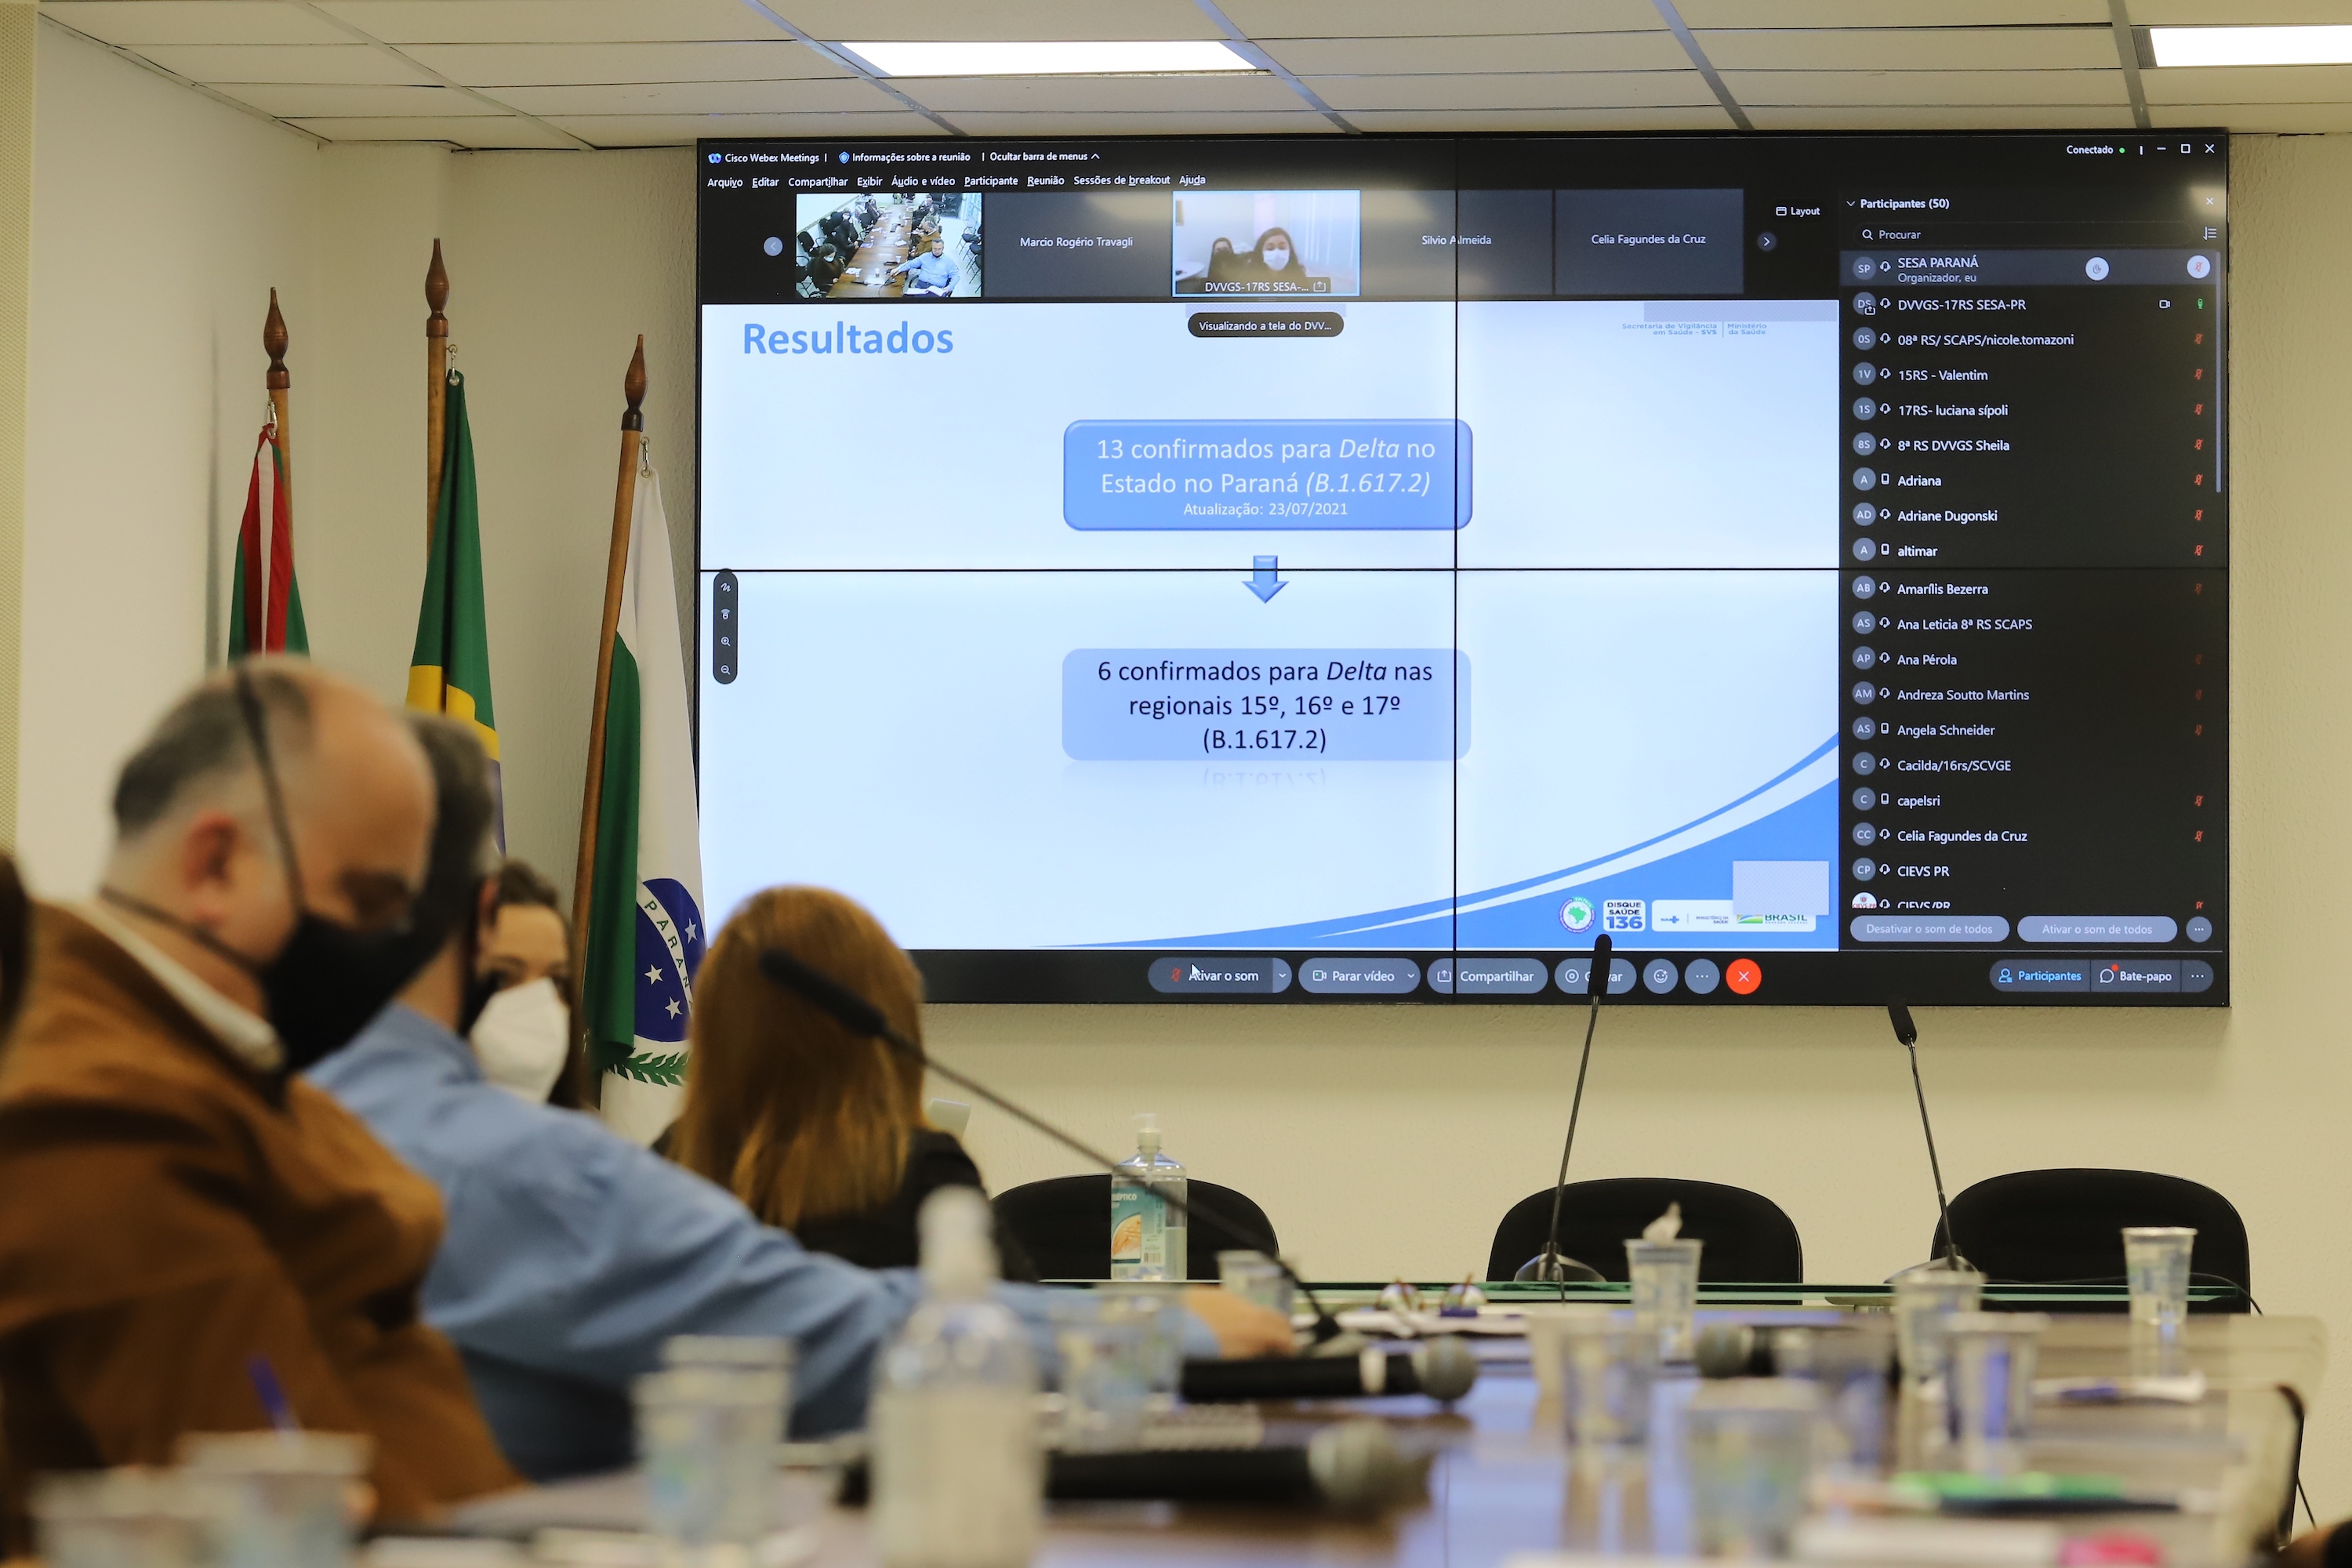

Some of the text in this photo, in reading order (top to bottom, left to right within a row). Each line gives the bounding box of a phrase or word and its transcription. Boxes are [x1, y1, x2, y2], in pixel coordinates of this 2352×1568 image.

[2066, 144, 2114, 154] Conectado
[724, 152, 820, 165] Cisco Webex Meetings
[852, 152, 906, 165] Informações
[906, 152, 931, 162] sobre
[938, 151, 971, 162] reunião
[989, 151, 1022, 162] Ocultar
[1022, 151, 1045, 162] barra
[1046, 151, 1058, 162] de
[706, 174, 1207, 190] Arquivo Editar Compartilhar Exibir Áudio e vídeo Participante Reunião Sessões de breakout Ajuda
[1860, 198, 1951, 211] Participantes (50)
[1790, 206, 1821, 218] Layout
[1421, 234, 1492, 245] Silvio Almeida
[1591, 233, 1707, 246] Celia Fagundes da Cruz
[1878, 229, 1922, 240] Procurar
[1019, 236, 1134, 249] Marcio Rogério Travagli
[1897, 253, 1980, 269] SESA PARANÁ
[1897, 272, 1977, 285] Organizador, eu
[1205, 281, 1271, 292] DVVGS-17RS
[1897, 299, 2027, 311] DVVGS-17RS SESA-PR
[1198, 321, 1258, 332] Visualizando
[1259, 322, 1267, 331] a
[1268, 320, 1287, 331] tela
[1288, 320, 1302, 331] do
[744, 321, 953, 354] Resultados
[1920, 334, 1942, 347] RS/
[1943, 333, 2074, 347] SCAPS/nicole.tomazoni
[1898, 369, 1929, 381] 15RS
[1938, 368, 1989, 381] Valentim
[1898, 404, 2009, 419] 17RS- luciana sípoli
[1098, 437, 1436, 463] 13 confirmados para Delta no
[1913, 440, 1929, 452] RS
[1931, 439, 1973, 452] DVVGS
[1975, 439, 2010, 452] Sheila
[1102, 471, 1430, 497] Estado no Paraná (B.1.617.2)
[1896, 474, 1942, 487] Adriana
[1184, 502, 1348, 518] Atualização: 23/07/2021
[1896, 509, 1998, 525] Adriane Dugonski
[1897, 544, 1939, 557] altimar
[1896, 583, 1989, 595] Amarílis Bezerra
[1896, 619, 1920, 630] Ana
[1922, 618, 1958, 630] Leticia
[1976, 619, 1992, 630] RS
[1994, 619, 2033, 630] SCAPS
[1896, 653, 1958, 666] Ana Pérola
[1098, 660, 1433, 685] 6 confirmados para Delta nas
[1896, 688, 2030, 701] Andreza Soutto Martins
[1131, 695, 1232, 720] regionais
[1341, 700, 1355, 716] e
[1896, 724, 1996, 739] Angela Schneider
[1204, 728, 1326, 753] (B.1.617.2)
[1896, 759, 2012, 773] Cacilda/16rs/SCVGE
[1896, 794, 1941, 810] capelsri
[1896, 829, 2028, 845] Celia Fagundes da Cruz
[1896, 866, 1951, 877] CIEVS PR
[1606, 916, 1643, 930] 136
[1866, 923, 1914, 934] Desativar
[1924, 926, 1947, 935] som
[1948, 924, 1962, 935] de
[1964, 924, 1994, 935] todos
[2042, 924, 2153, 935] Ativar o som de todos
[1224, 972, 1232, 982] o
[1234, 972, 1259, 982] som
[1332, 970, 1396, 982] Parar vídeo
[1460, 970, 1535, 985] Compartilhar
[2018, 970, 2082, 984] Participantes
[2119, 970, 2172, 984] Bate-papo
